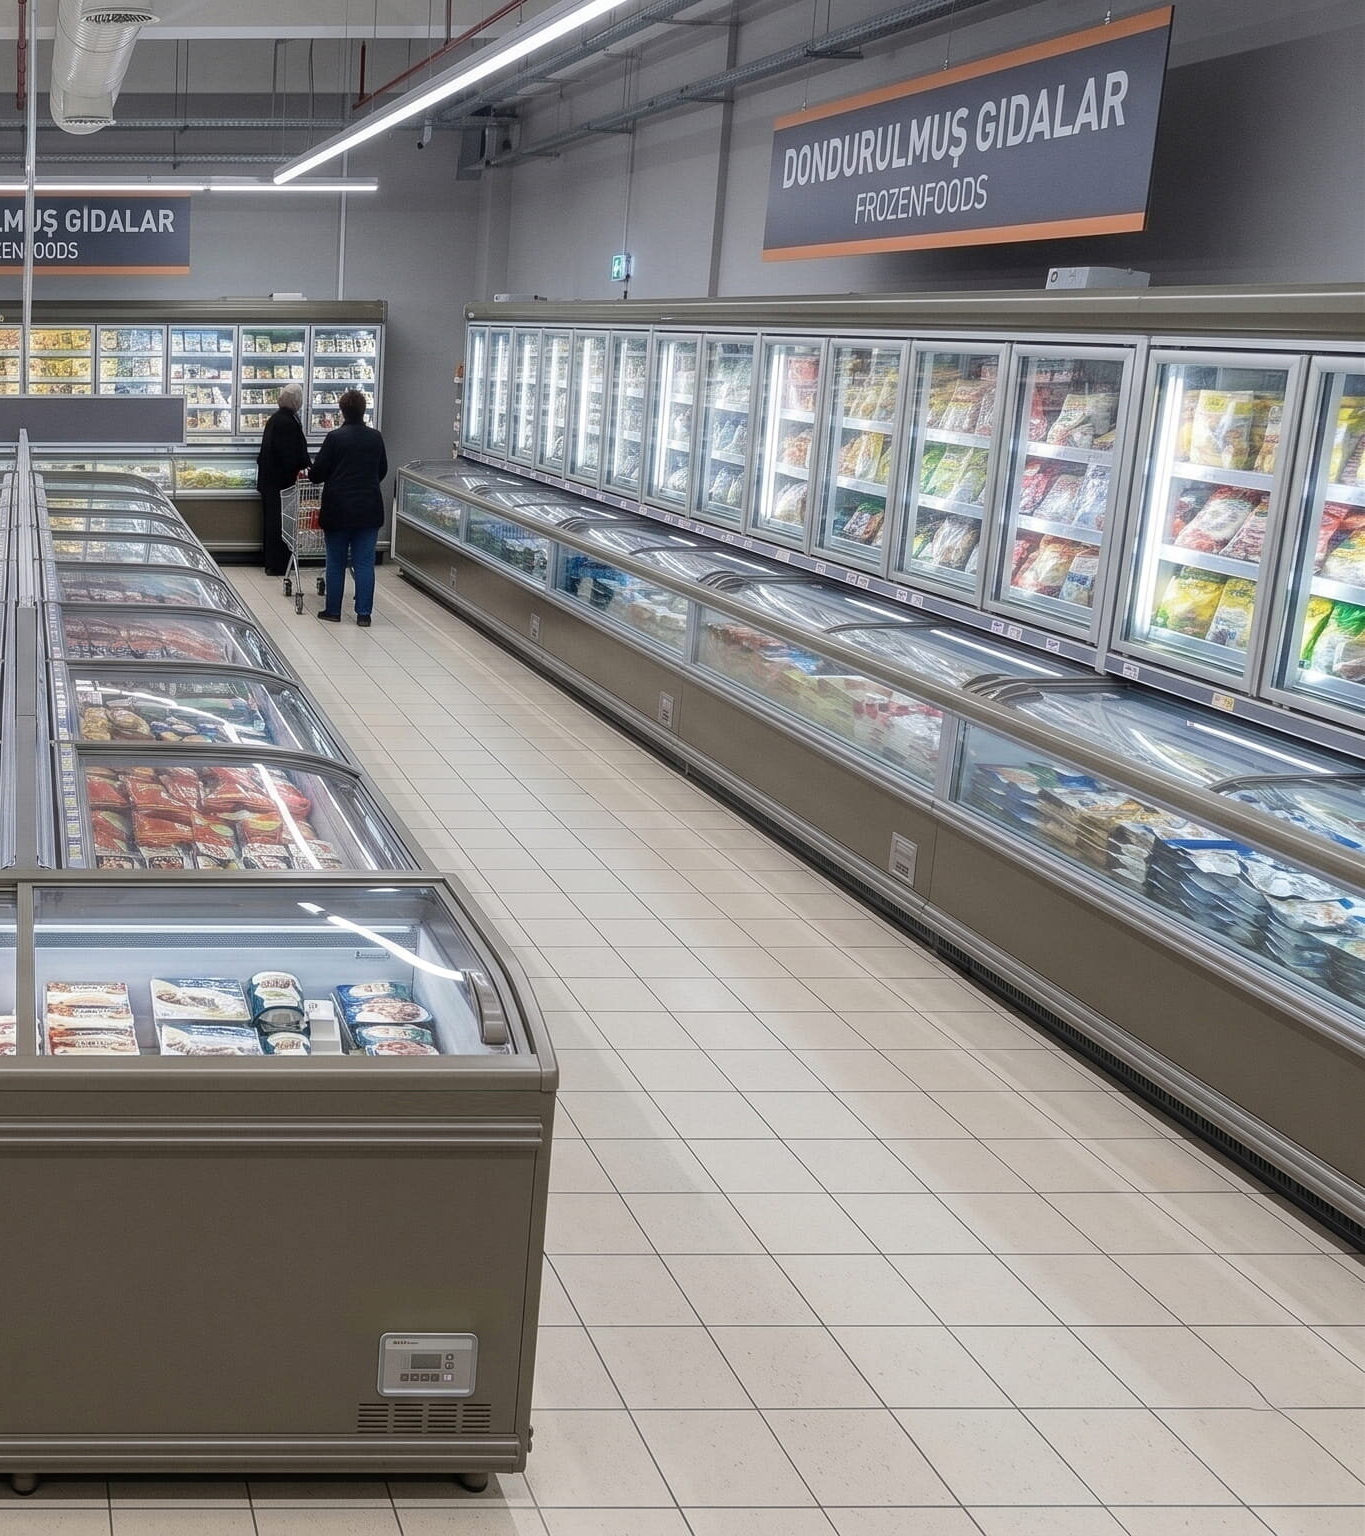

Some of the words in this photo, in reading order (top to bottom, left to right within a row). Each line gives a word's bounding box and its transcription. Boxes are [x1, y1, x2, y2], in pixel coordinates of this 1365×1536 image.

[782, 107, 969, 188] DONDURULMUŞ
[976, 70, 1129, 152] GIDALAR
[854, 174, 989, 225] FROZENFOODS
